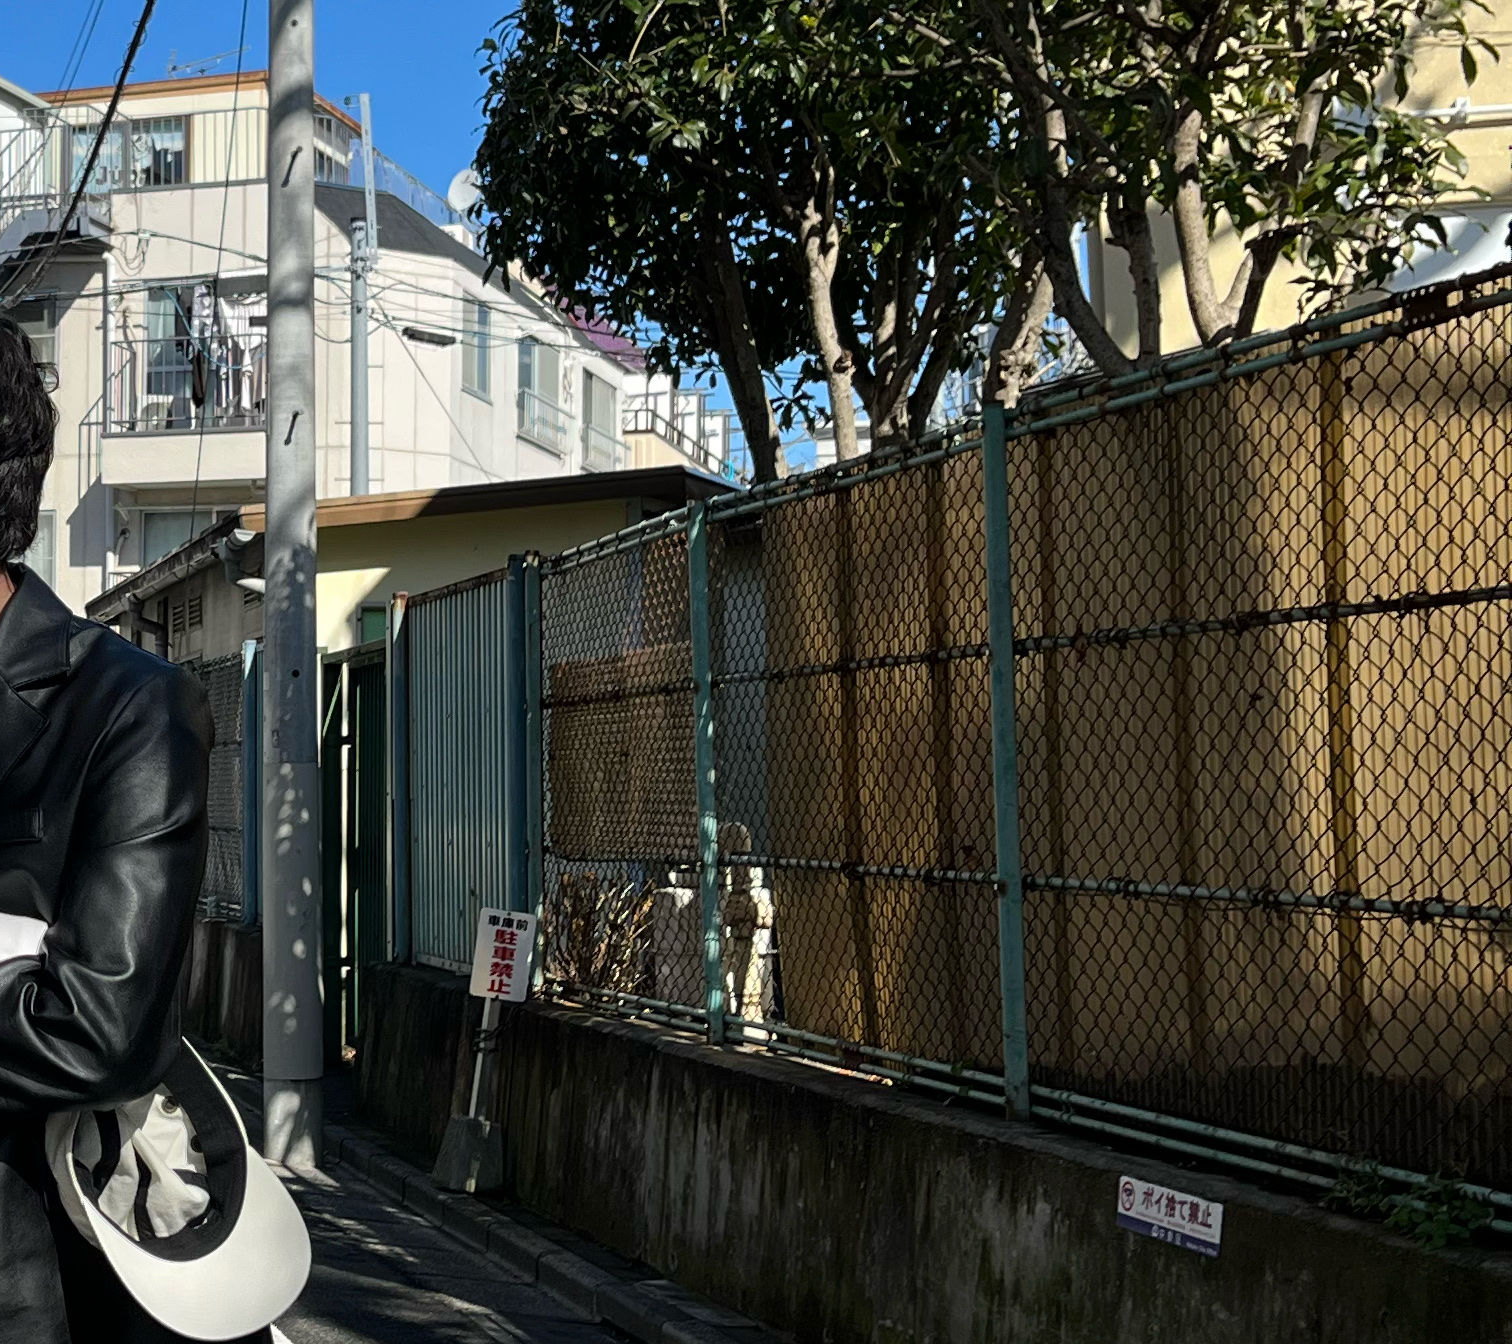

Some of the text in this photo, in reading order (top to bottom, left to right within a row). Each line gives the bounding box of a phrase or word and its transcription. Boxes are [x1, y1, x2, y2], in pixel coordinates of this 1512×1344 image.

[488, 915, 529, 931] 車庫前
[487, 929, 519, 994] 駐車禁止
[1141, 1186, 1213, 1229] ポイ捨て禁止
